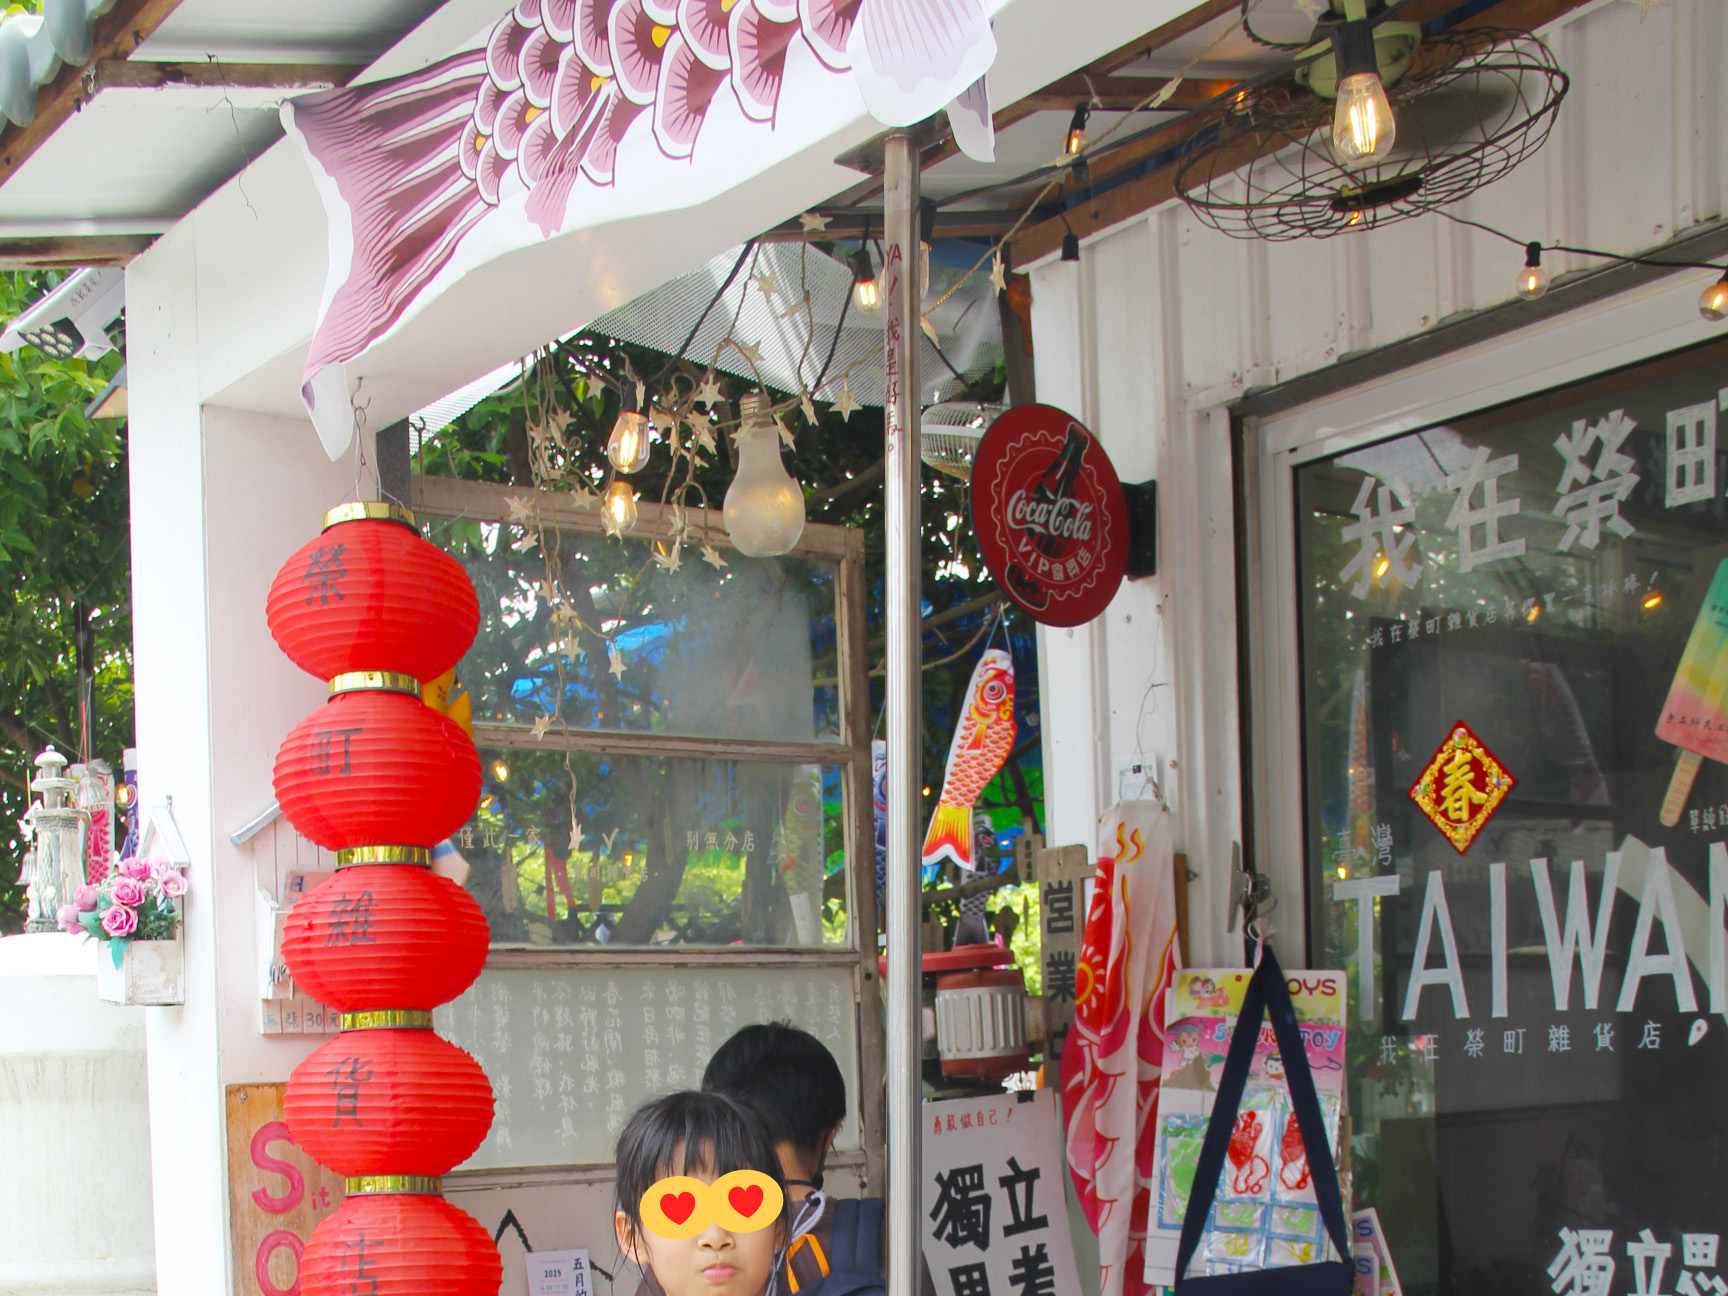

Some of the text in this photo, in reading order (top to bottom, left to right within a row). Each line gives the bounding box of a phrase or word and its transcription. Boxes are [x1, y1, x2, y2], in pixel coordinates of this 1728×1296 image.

[1006, 488, 1094, 541] Coca-Cola
[1439, 749, 1488, 823] 春
[459, 824, 543, 850] 僅此一家
[686, 831, 756, 852] 別無分店
[1287, 977, 1338, 996] OYS
[1380, 1020, 1662, 1066] 我在榮町雜貨店
[929, 1156, 1049, 1252] 獨立
